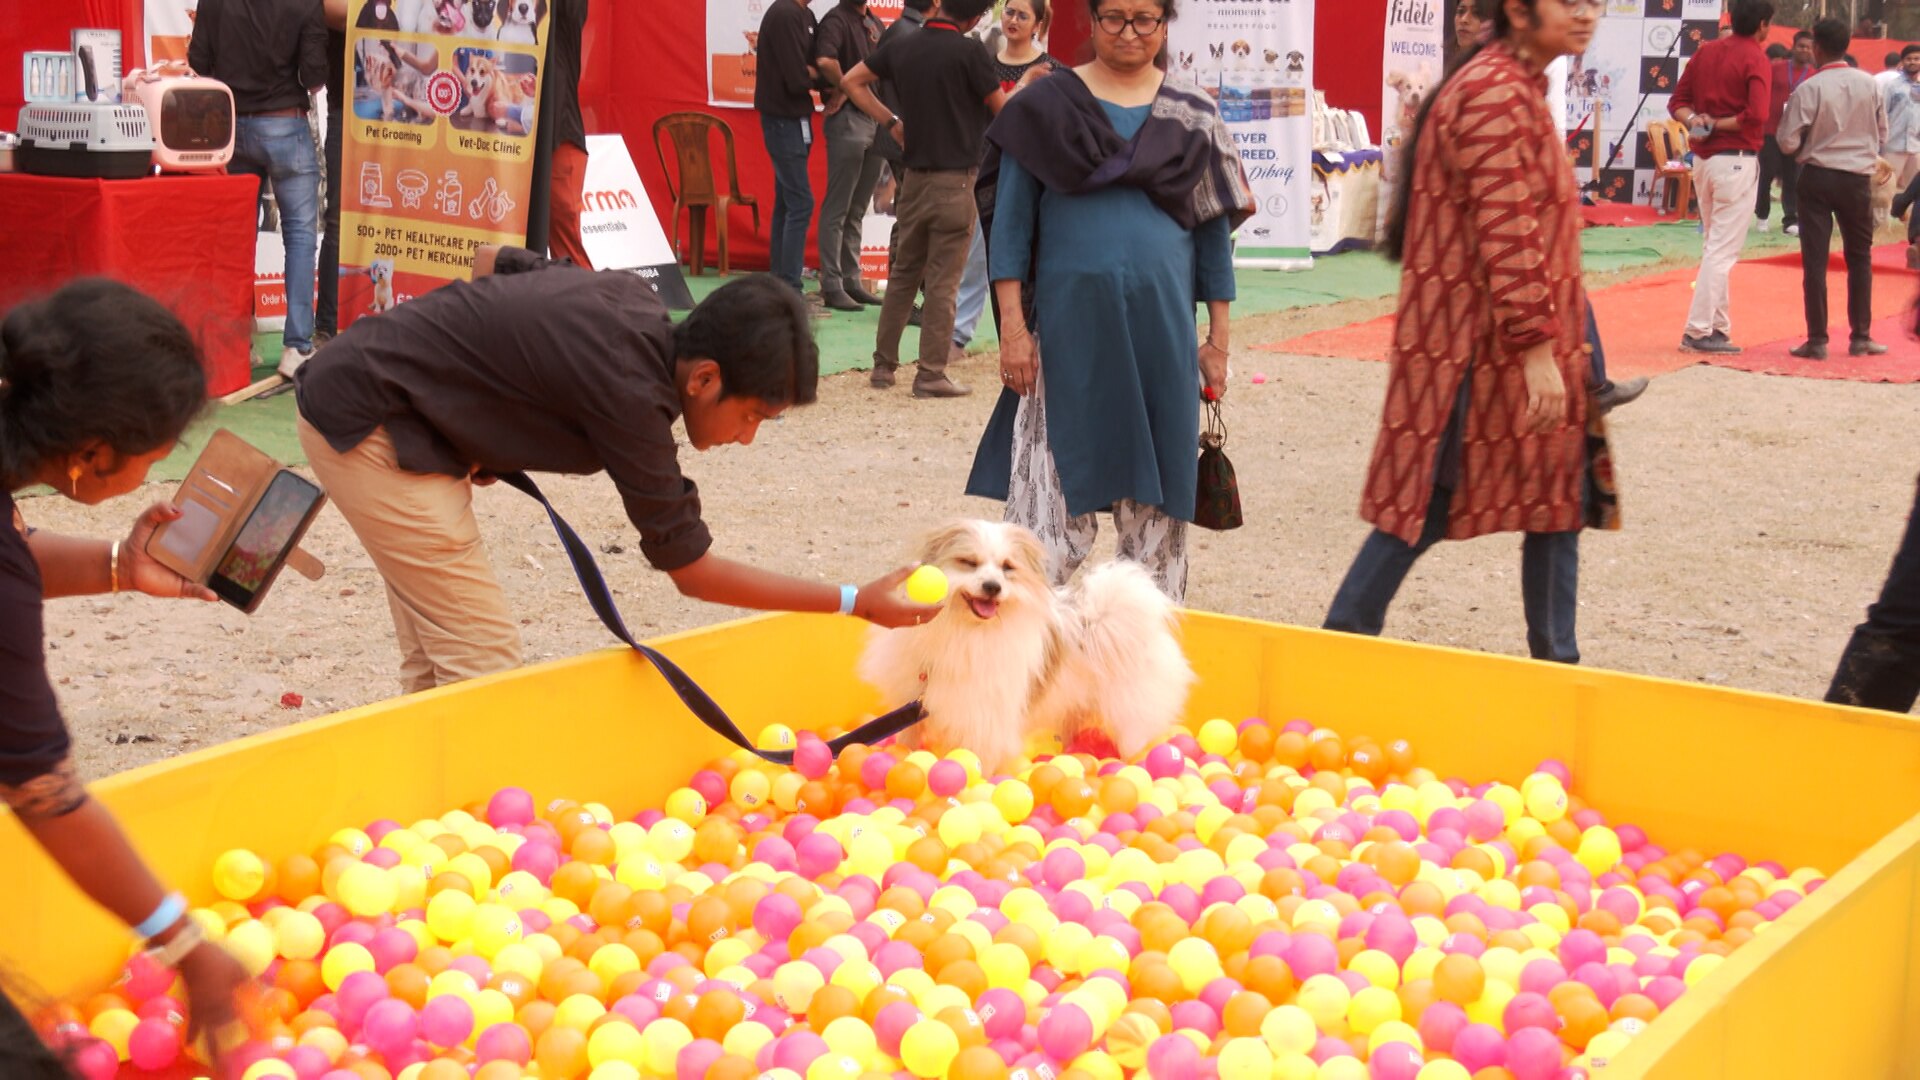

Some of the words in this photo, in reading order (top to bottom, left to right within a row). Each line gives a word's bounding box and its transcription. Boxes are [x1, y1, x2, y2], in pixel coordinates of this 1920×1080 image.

[1217, 9, 1266, 17] moments
[1390, 0, 1434, 26] fidèle
[1391, 40, 1437, 57] WELCOME
[366, 126, 380, 138] Pet
[382, 128, 422, 145] Grooming
[459, 136, 490, 151] Vet-Doc
[493, 139, 522, 155] Clinic
[1238, 149, 1279, 161] REED.
[582, 189, 637, 211] rma
[582, 220, 628, 234] essentials
[357, 225, 381, 237] 500+
[385, 227, 401, 241] PET
[406, 231, 463, 249] HEALTHCARE
[374, 243, 403, 257] 2000+
[407, 247, 423, 260] PET
[261, 293, 280, 305] Order
